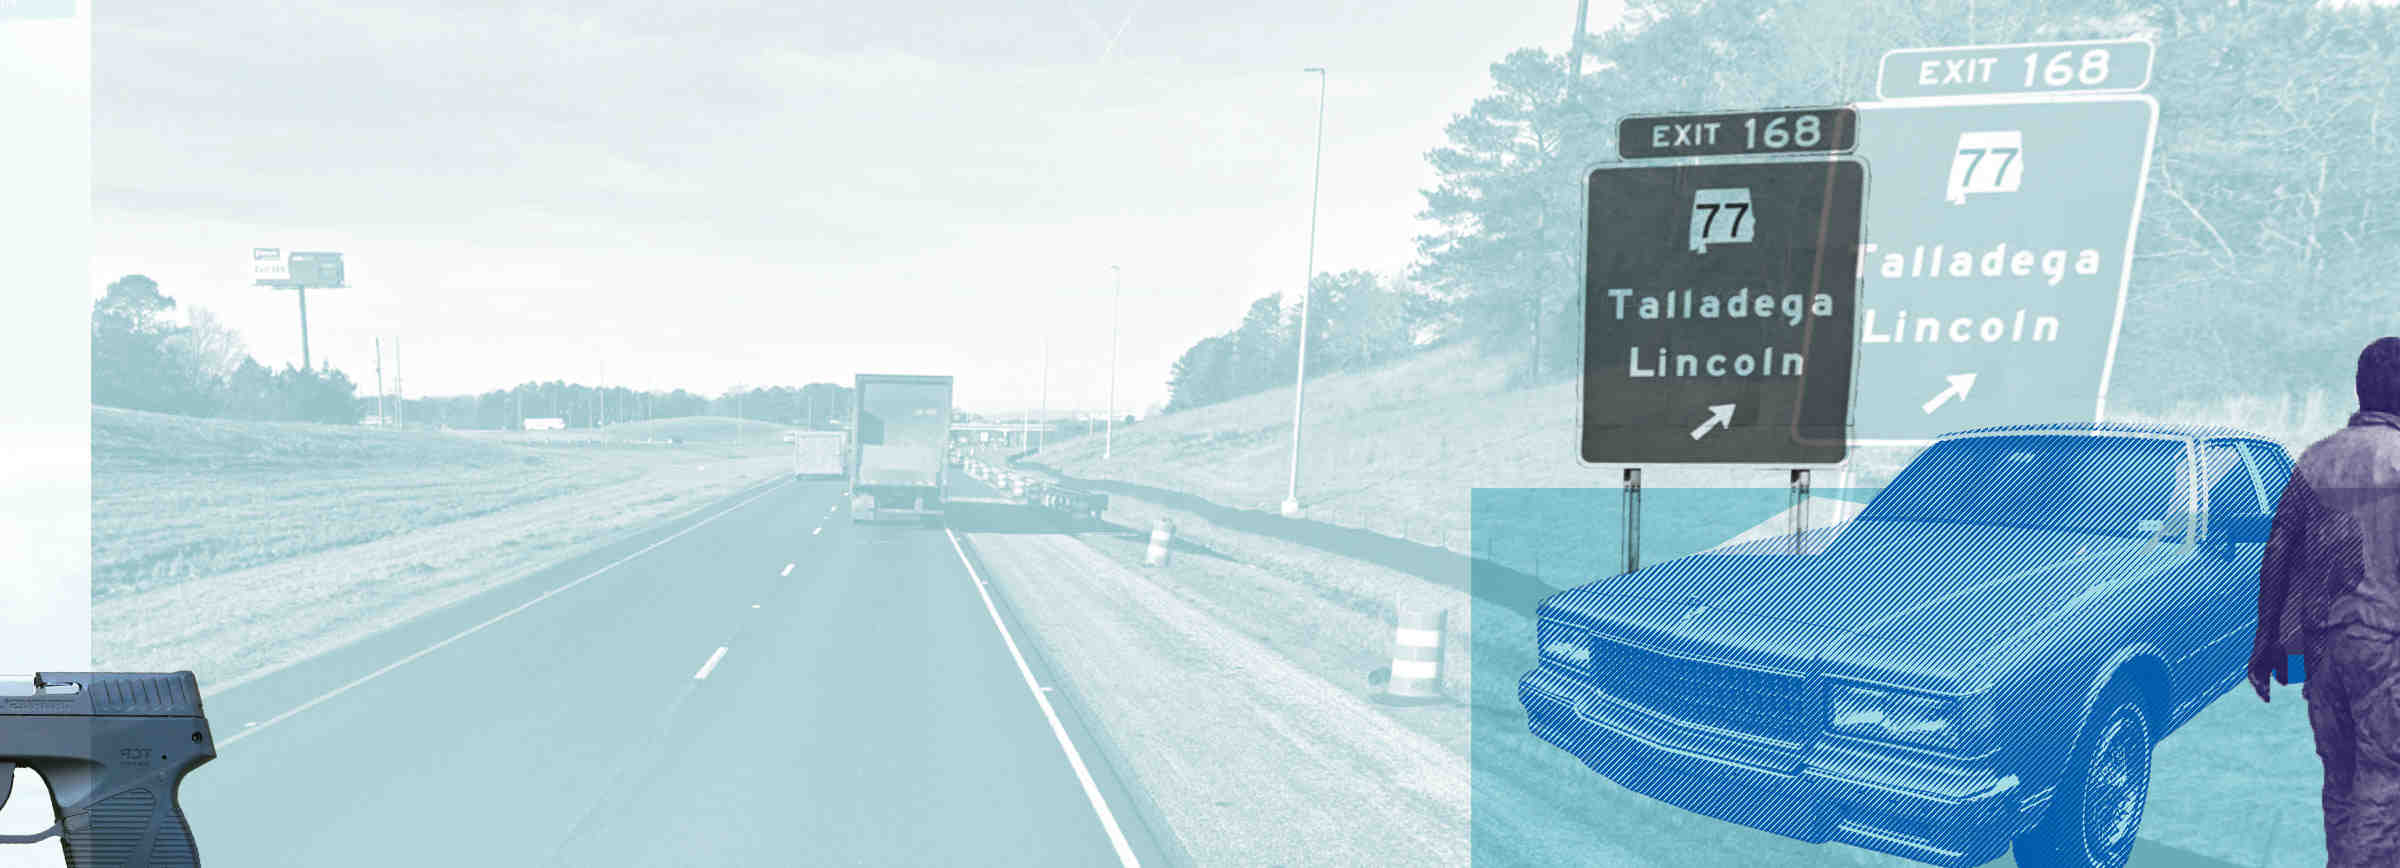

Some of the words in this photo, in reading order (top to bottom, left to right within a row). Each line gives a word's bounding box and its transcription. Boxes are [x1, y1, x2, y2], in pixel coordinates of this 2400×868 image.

[1919, 57, 1998, 86] EXIT
[2023, 49, 2111, 88] 168
[1652, 123, 1720, 148] EXIT
[1745, 115, 1822, 149] 168
[1958, 147, 2019, 188] 77
[1696, 203, 1750, 239] 77
[1856, 243, 2100, 287] Talladega
[1607, 289, 1834, 326] Talladega
[1862, 307, 2059, 344] Lincoln
[1630, 347, 1805, 379] Lincoln
